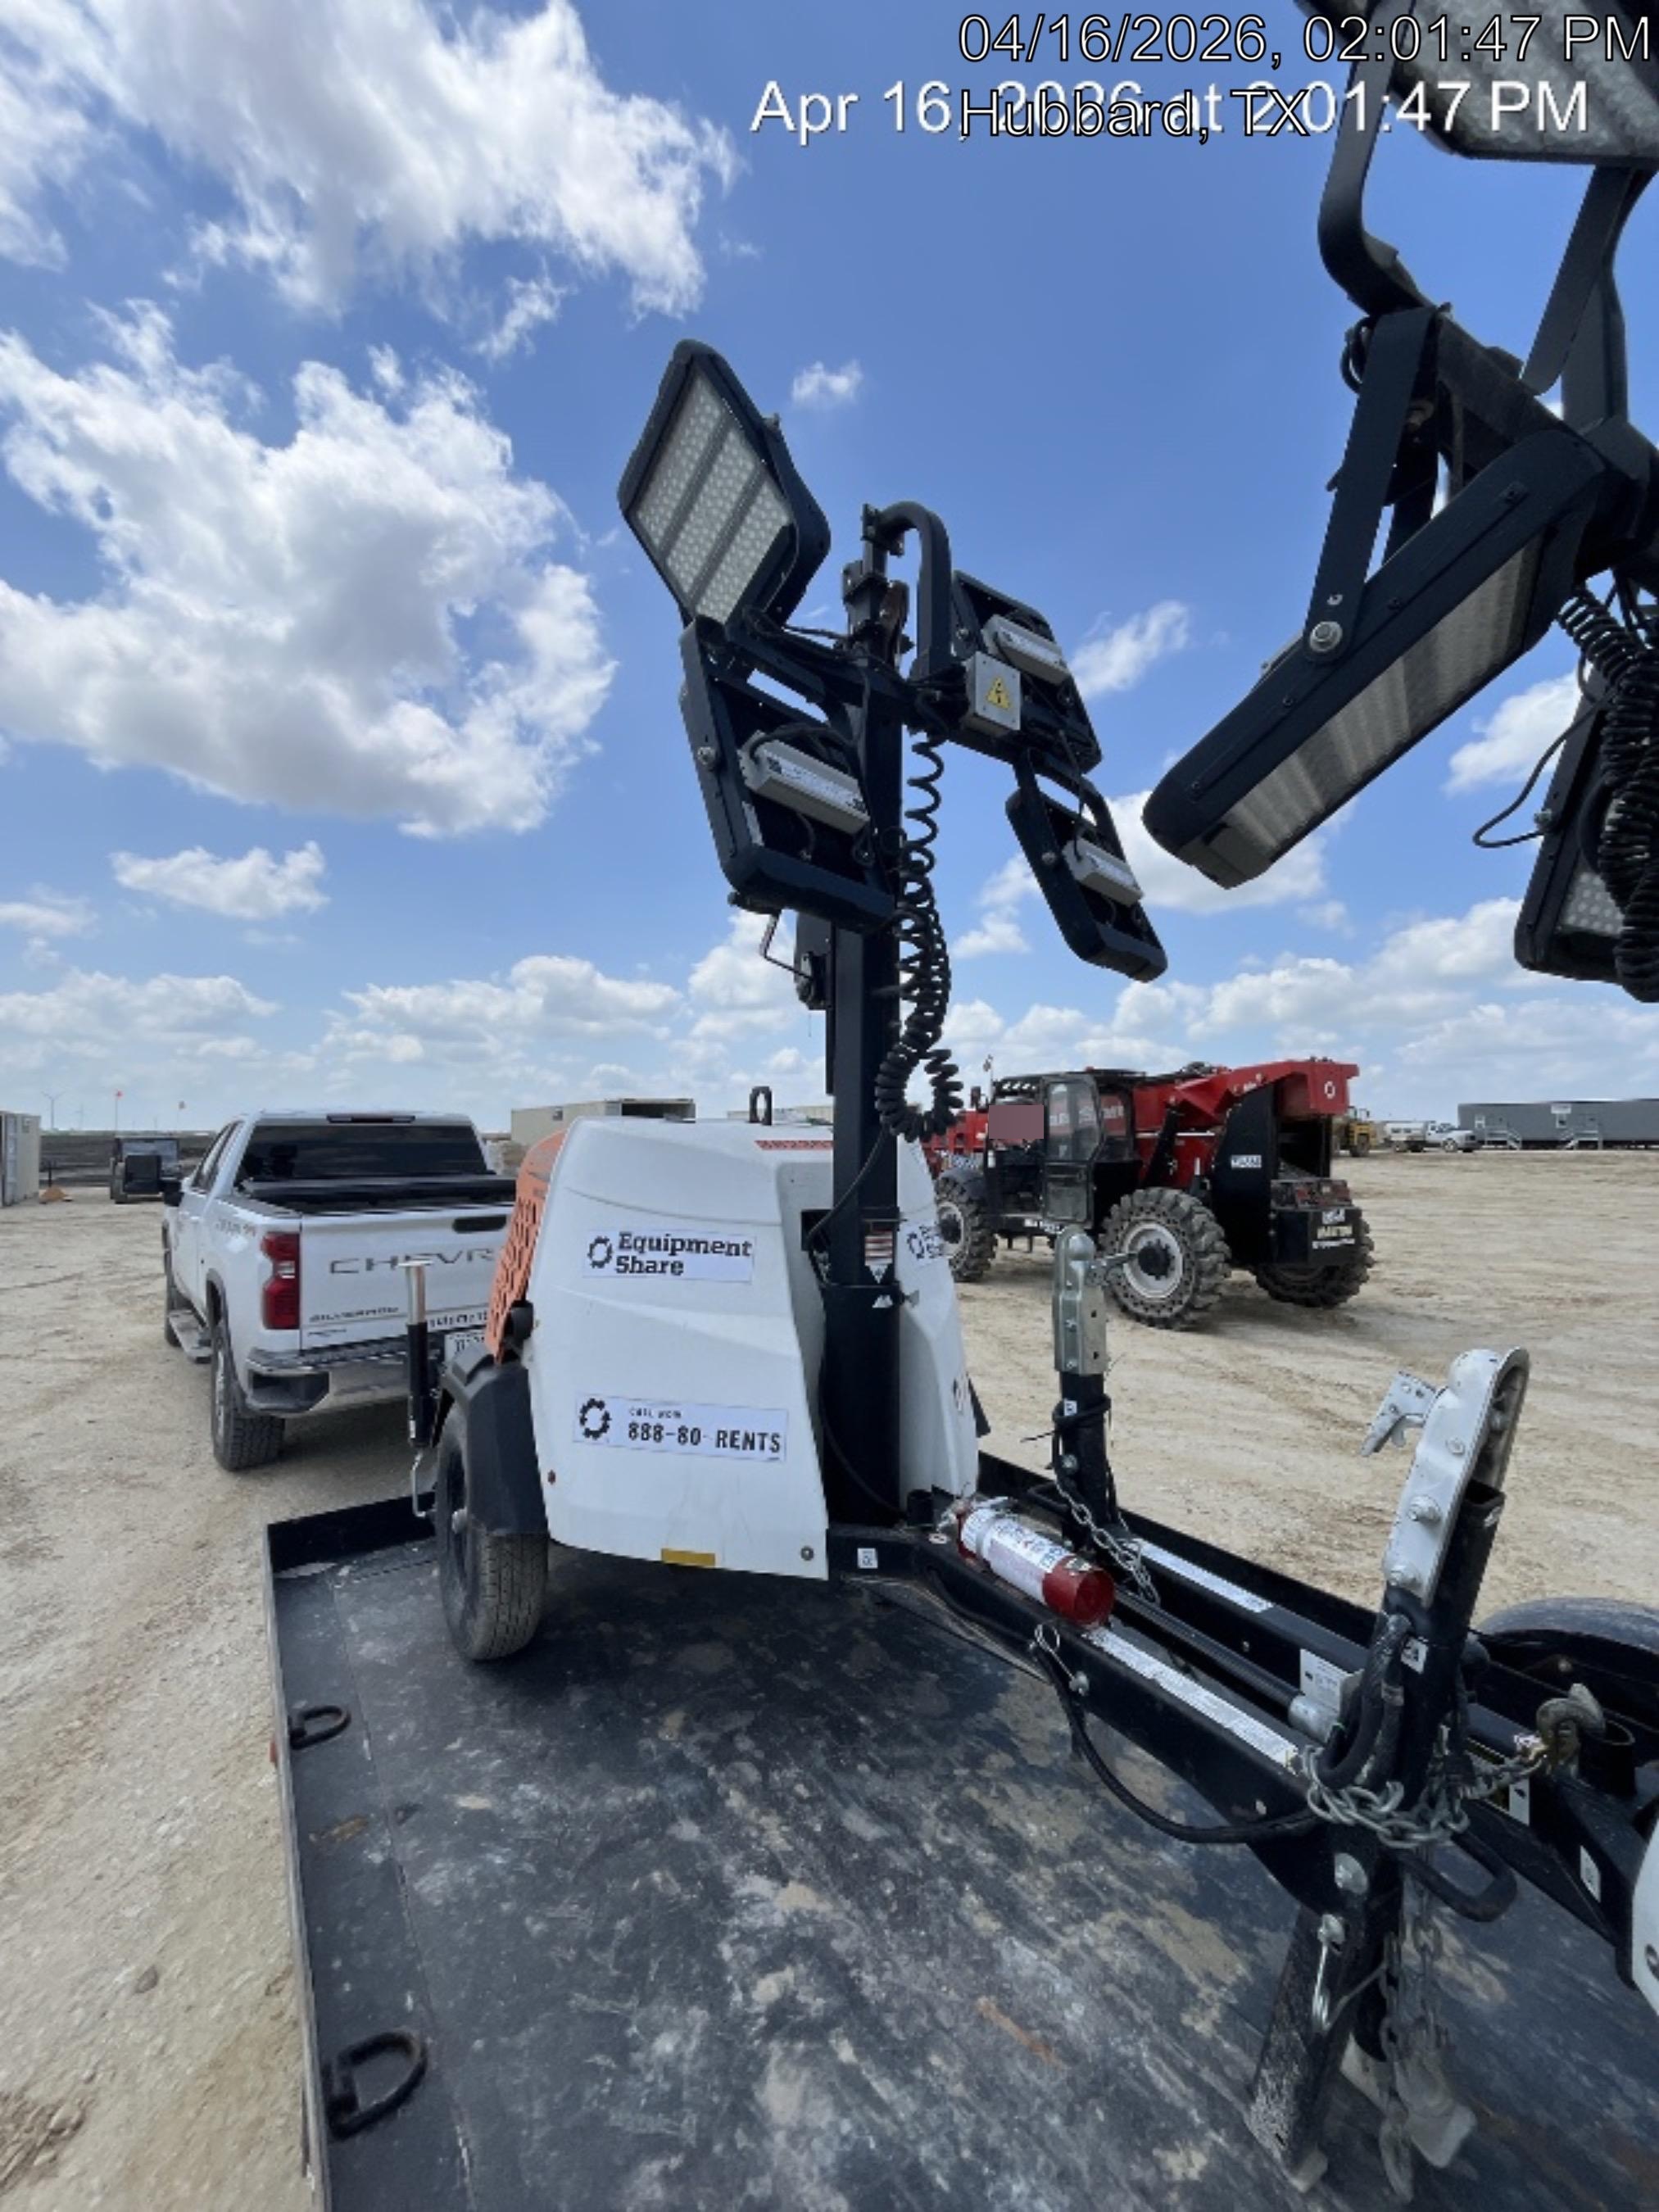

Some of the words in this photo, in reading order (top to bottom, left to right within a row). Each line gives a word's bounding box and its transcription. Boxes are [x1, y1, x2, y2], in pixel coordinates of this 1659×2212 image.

[619, 1231, 752, 1257] Equipment
[615, 1255, 684, 1276] Share
[715, 1430, 781, 1453] RENTS
